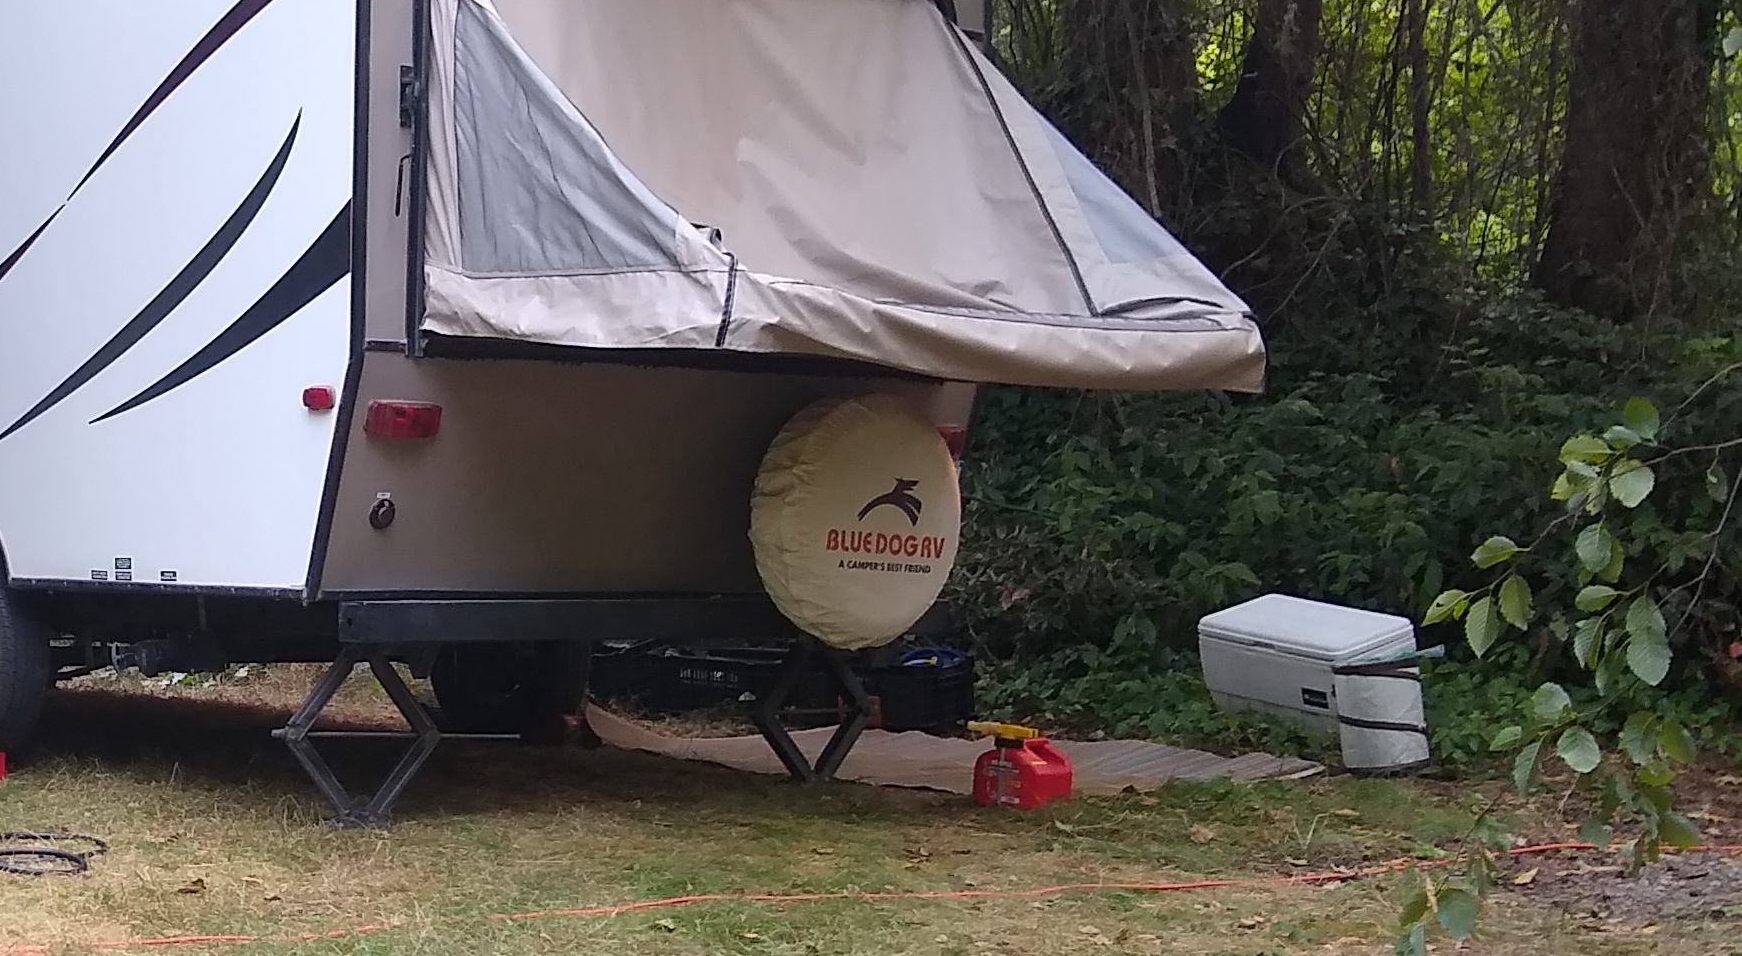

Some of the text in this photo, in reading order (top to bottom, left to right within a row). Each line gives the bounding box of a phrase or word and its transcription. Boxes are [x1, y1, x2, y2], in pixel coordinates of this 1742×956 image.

[838, 559, 931, 574] A CAMPER'S BEST FRIEND
